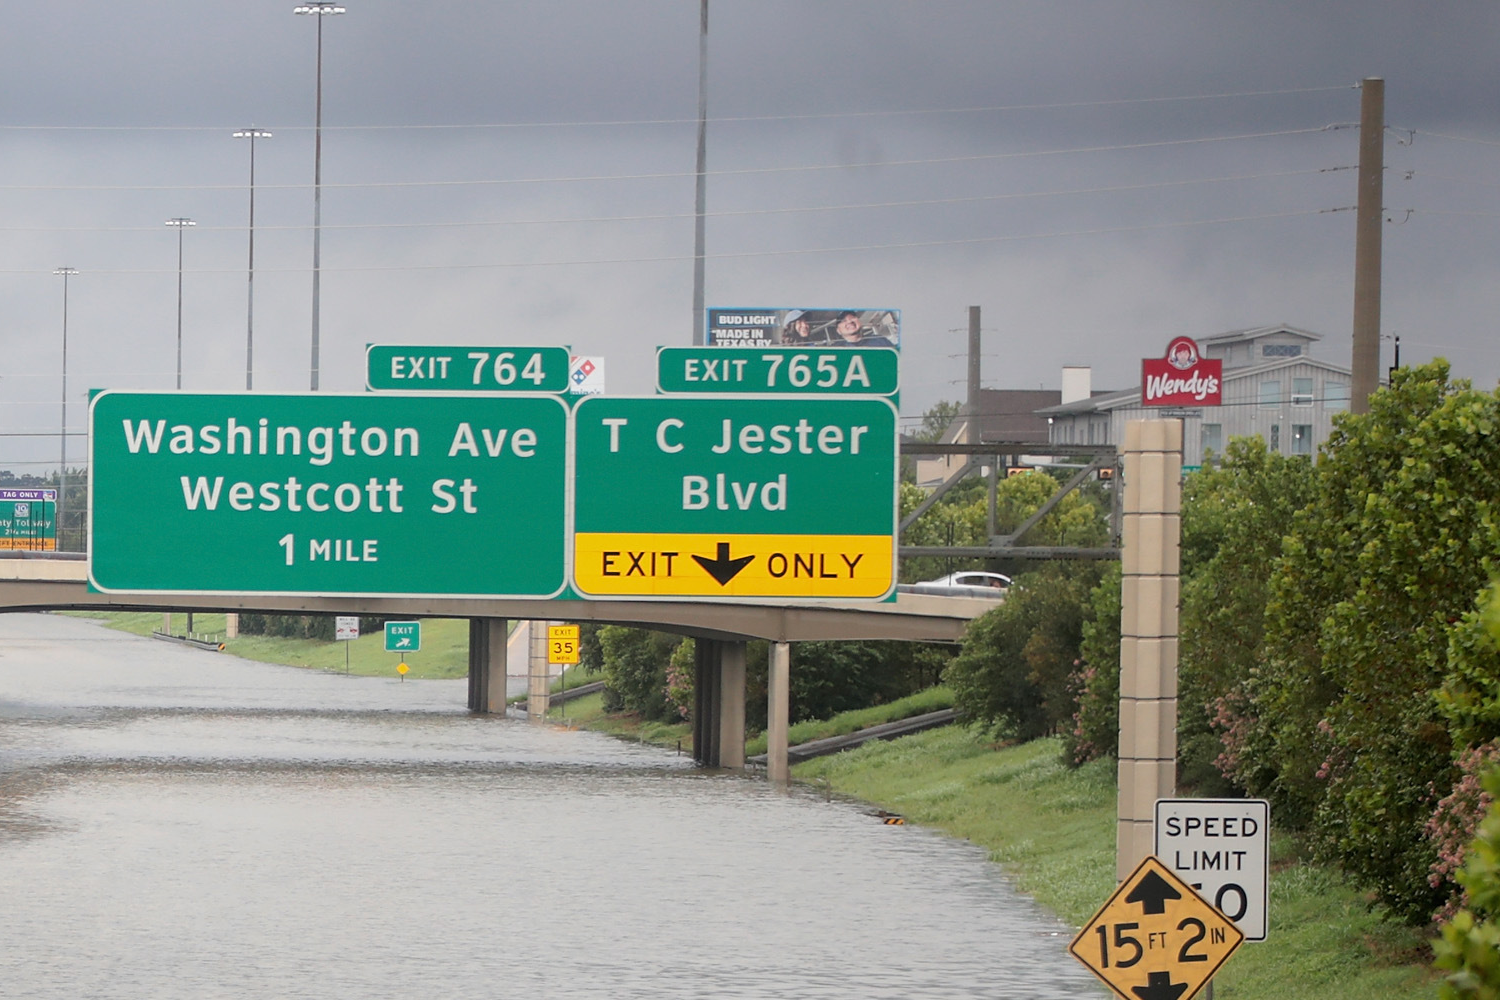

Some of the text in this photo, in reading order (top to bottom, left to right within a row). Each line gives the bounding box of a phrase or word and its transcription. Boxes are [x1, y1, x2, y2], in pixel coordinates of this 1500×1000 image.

[718, 315, 776, 325] BUD LIGHT
[751, 329, 764, 339] IN
[716, 339, 756, 347] TEXAS
[390, 352, 547, 386] EXIT 764
[683, 354, 871, 388] EXIT 765A
[1146, 370, 1219, 401] Wendy's
[122, 417, 538, 466] Washington Ave
[601, 417, 869, 455] T C Jester
[180, 475, 478, 515] Westcott St
[681, 473, 787, 511] Blvd
[277, 533, 379, 566] 1 MILE
[601, 551, 864, 579] EXIT ONLY
[391, 626, 414, 635] EXIT
[553, 642, 574, 654] 35
[1165, 817, 1259, 837] SPEED
[1175, 850, 1247, 871] LIMIT
[1190, 882, 1248, 923] 0
[1095, 917, 1226, 969] 15 FT 2 IN
